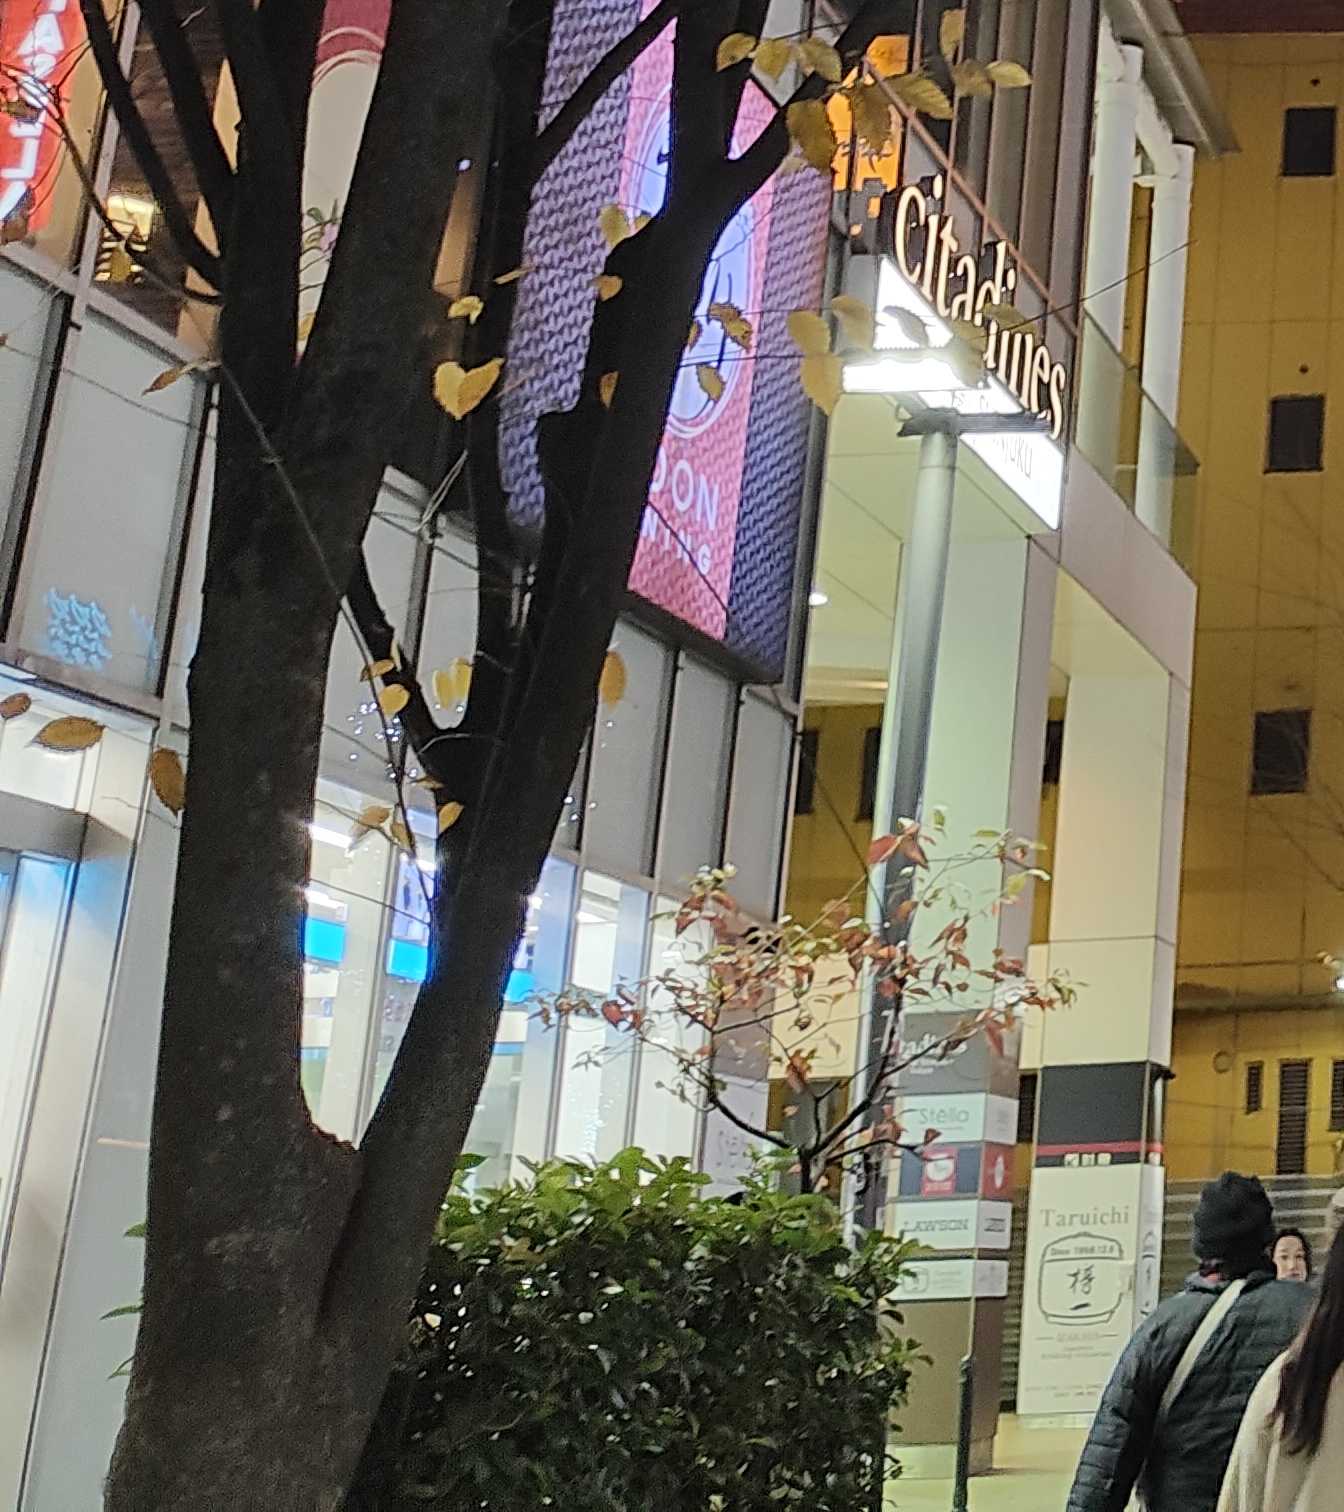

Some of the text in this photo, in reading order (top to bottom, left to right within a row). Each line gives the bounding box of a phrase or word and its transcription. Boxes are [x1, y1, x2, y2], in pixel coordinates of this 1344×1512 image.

[918, 1106, 970, 1126] Stella
[902, 1218, 970, 1233] LAWSON
[1040, 1205, 1130, 1228] Taruichi
